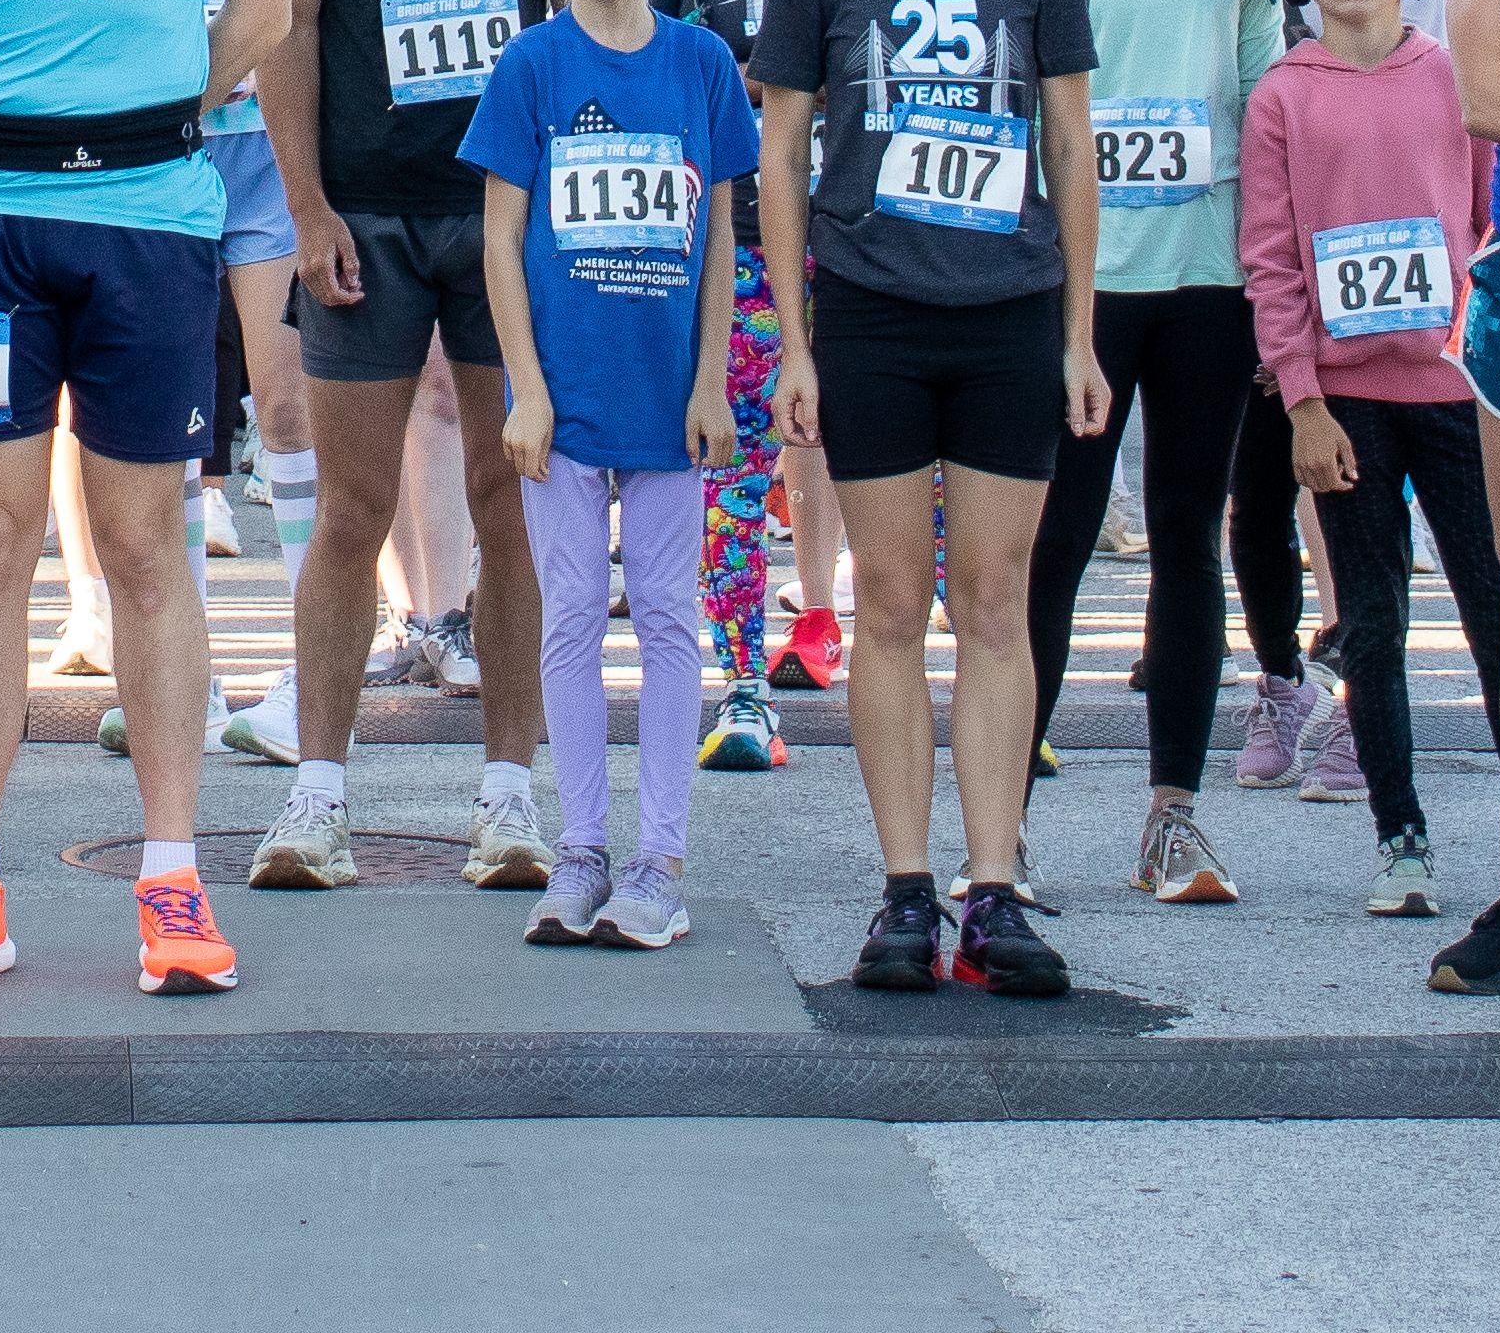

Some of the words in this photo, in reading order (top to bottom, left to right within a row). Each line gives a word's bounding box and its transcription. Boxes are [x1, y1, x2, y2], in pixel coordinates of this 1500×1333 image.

[397, 1, 437, 18] BRIDGE
[398, 16, 512, 78] 1119
[899, 84, 980, 107] YEARS
[1125, 108, 1148, 121] THE
[1149, 108, 1171, 120] GAP
[947, 120, 971, 136] THE
[970, 123, 994, 138] GAP
[565, 144, 605, 160] BRIDGE
[606, 144, 629, 157] THE
[629, 144, 651, 158] GAP
[1095, 130, 1187, 182] 823
[62, 159, 103, 169] FLIPBELT
[906, 141, 1001, 202] 107
[563, 168, 679, 223] 1134
[1366, 232, 1387, 247] THE
[1388, 229, 1411, 244] GAP
[574, 257, 633, 271] AMERICAN
[635, 259, 685, 274] NATIONAL
[609, 270, 691, 287] CHAMPIONSHIPS
[1338, 253, 1432, 310] 824
[647, 286, 669, 298] IOWA
